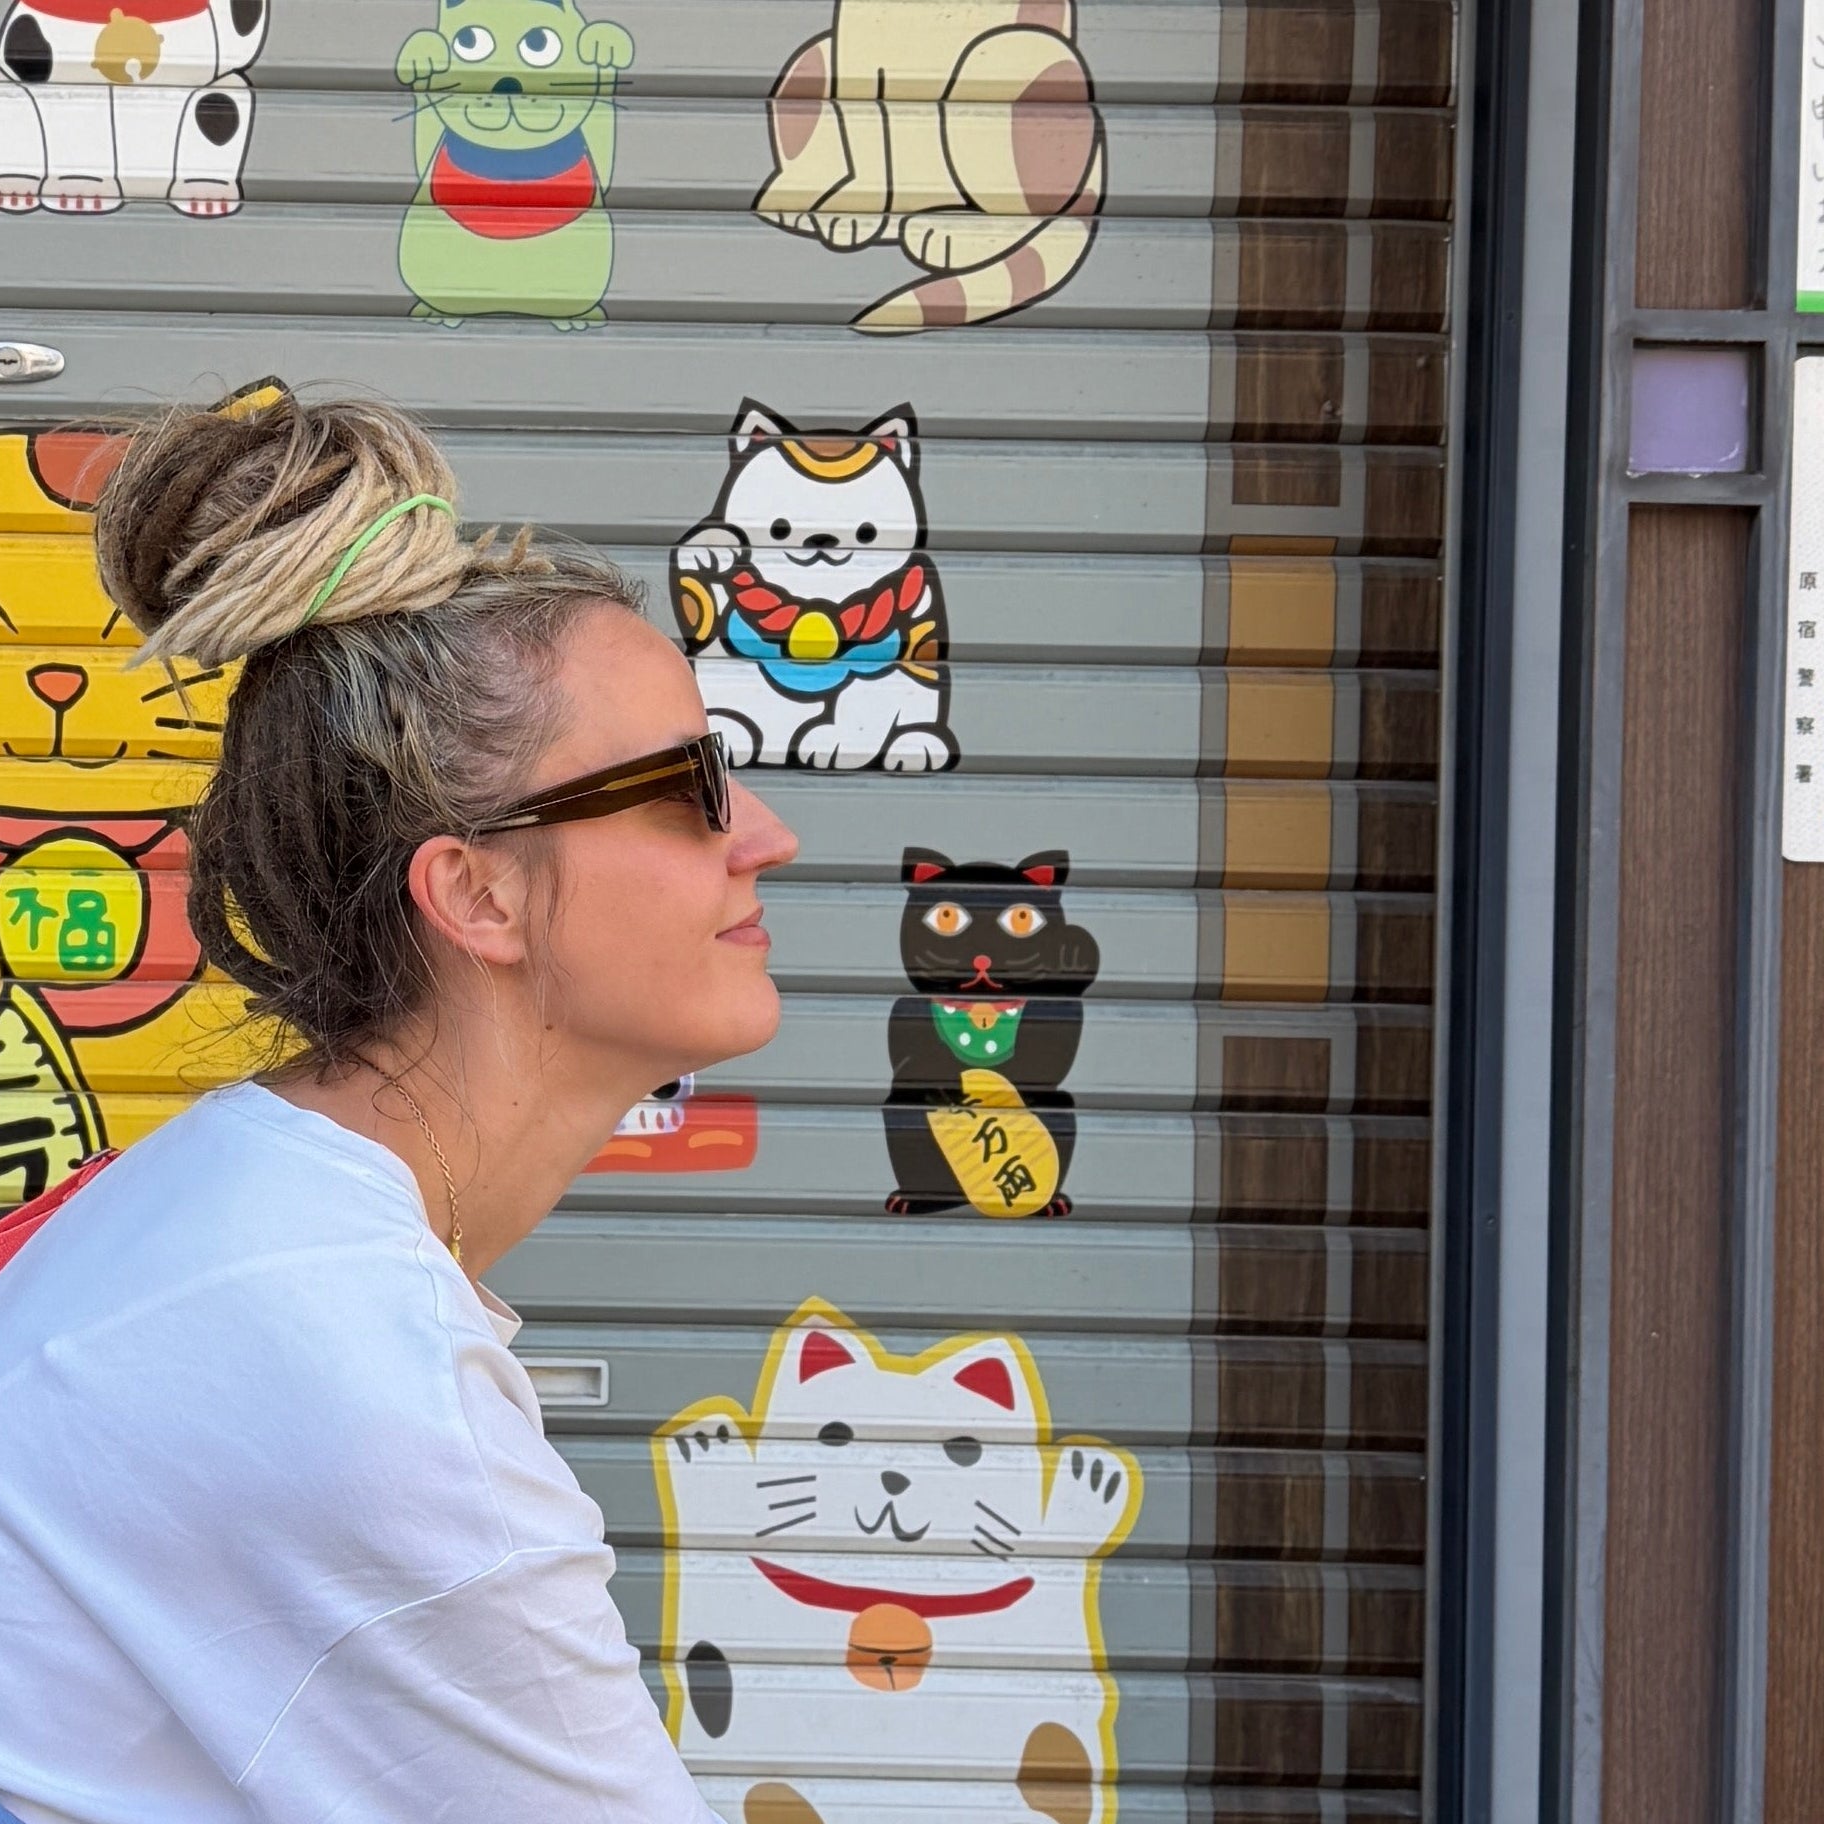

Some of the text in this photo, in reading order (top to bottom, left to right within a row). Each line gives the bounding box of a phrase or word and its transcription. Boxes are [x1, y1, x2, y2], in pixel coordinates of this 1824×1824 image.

[1794, 571, 1818, 783] 原宿警察署
[6, 869, 116, 972] 福
[950, 1093, 1037, 1208] 万両
